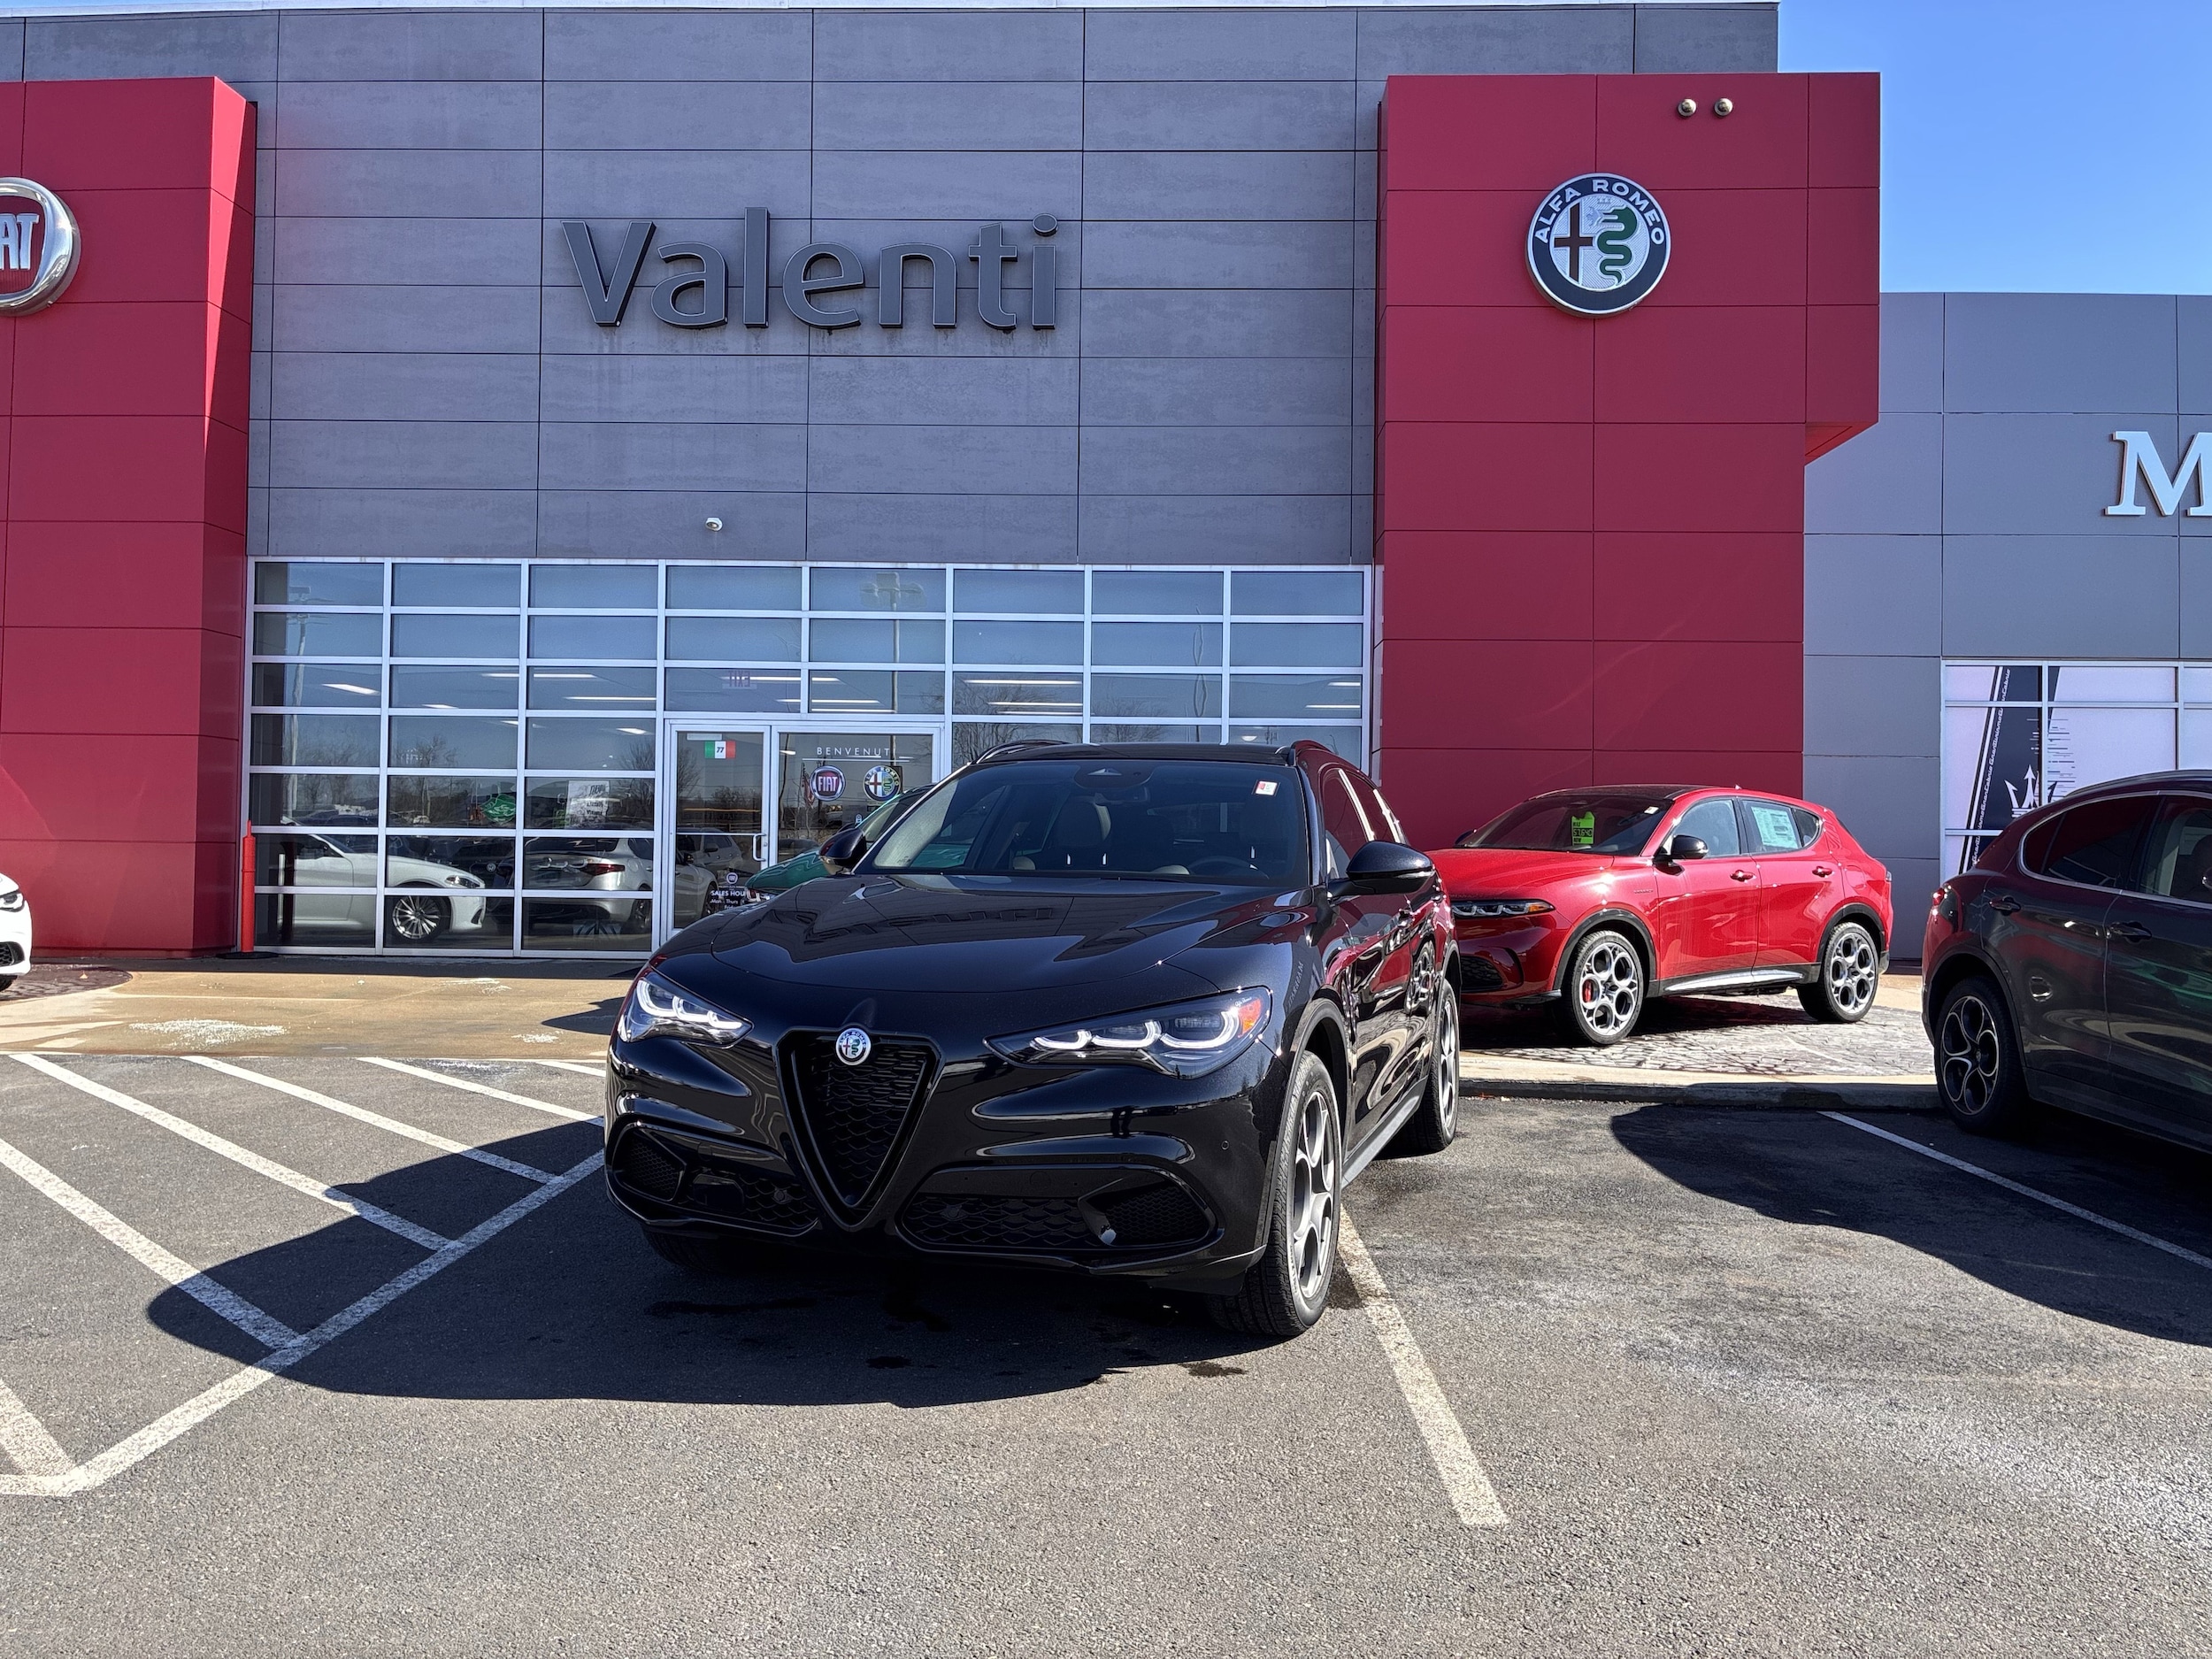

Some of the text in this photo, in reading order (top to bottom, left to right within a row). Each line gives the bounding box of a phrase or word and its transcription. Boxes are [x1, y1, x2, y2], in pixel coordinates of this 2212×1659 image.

[1534, 180, 1665, 245] ALFA ROMEO
[560, 207, 1059, 328] Valenti
[818, 776, 838, 792] FIAT
[864, 766, 899, 786] ALFA ROMEO
